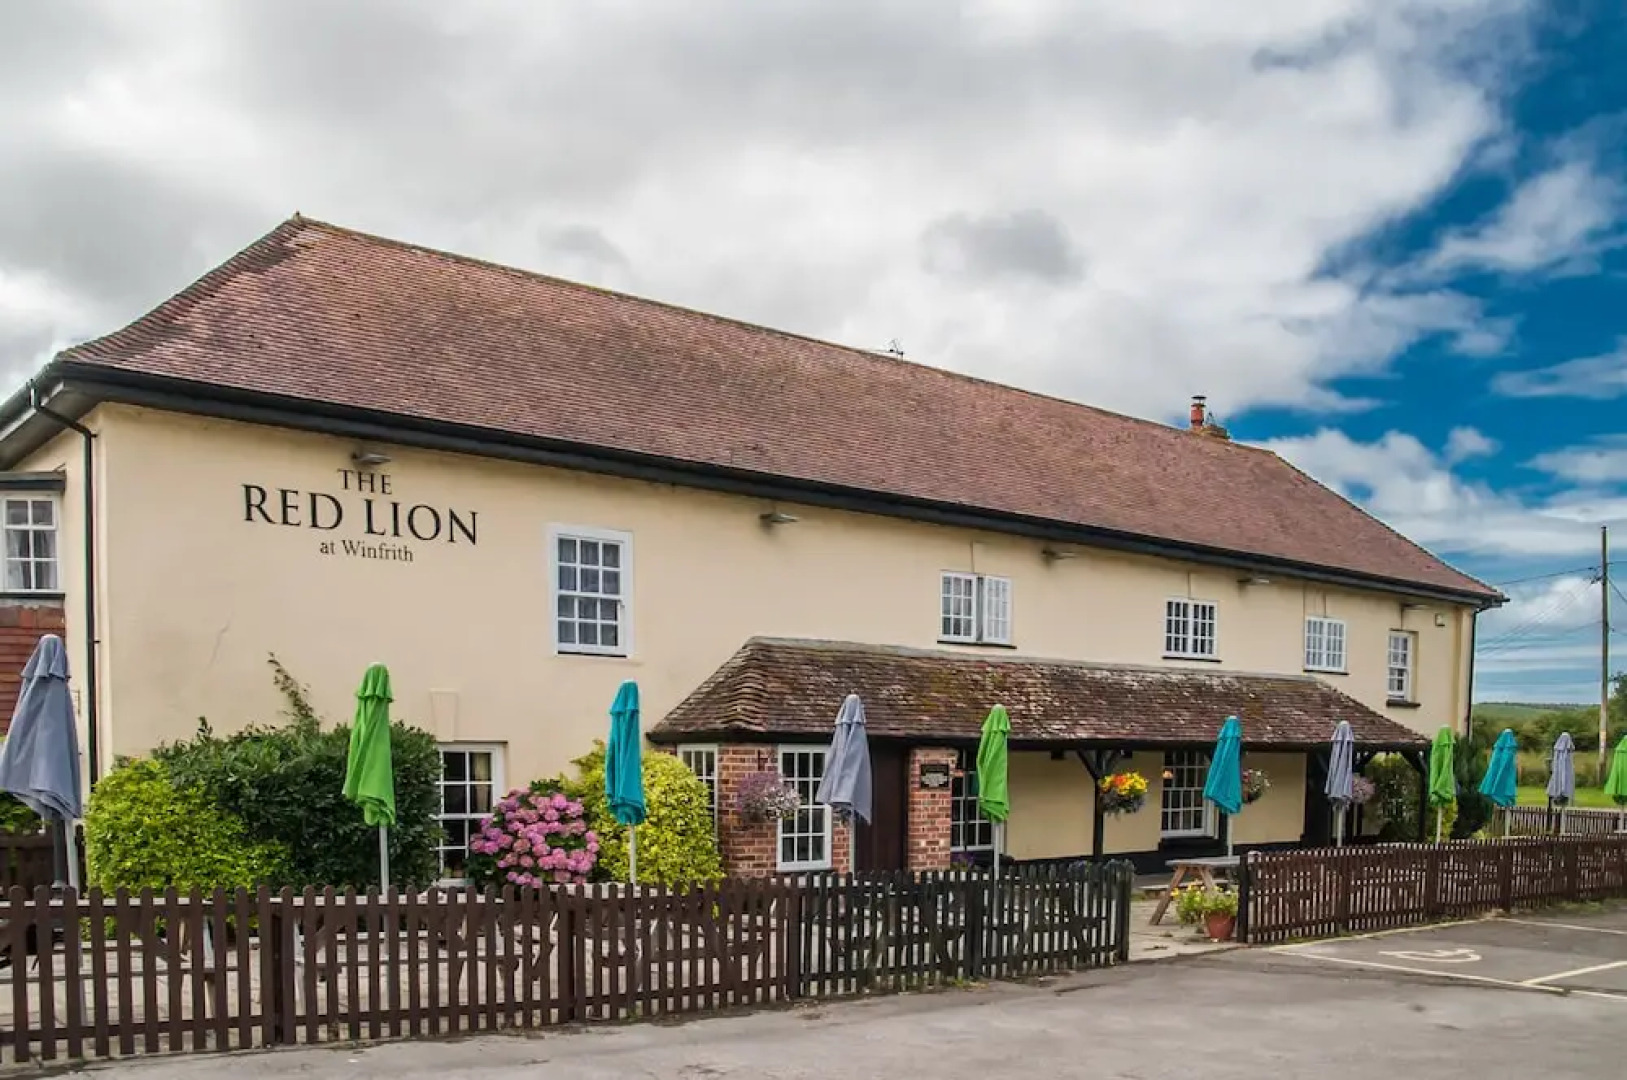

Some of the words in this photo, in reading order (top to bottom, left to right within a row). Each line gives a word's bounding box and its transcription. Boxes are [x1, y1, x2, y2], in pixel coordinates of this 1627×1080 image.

[337, 468, 393, 495] THE
[241, 484, 343, 530] RED
[364, 498, 479, 546] LION
[320, 540, 335, 555] at
[342, 540, 414, 562] Winfrith
